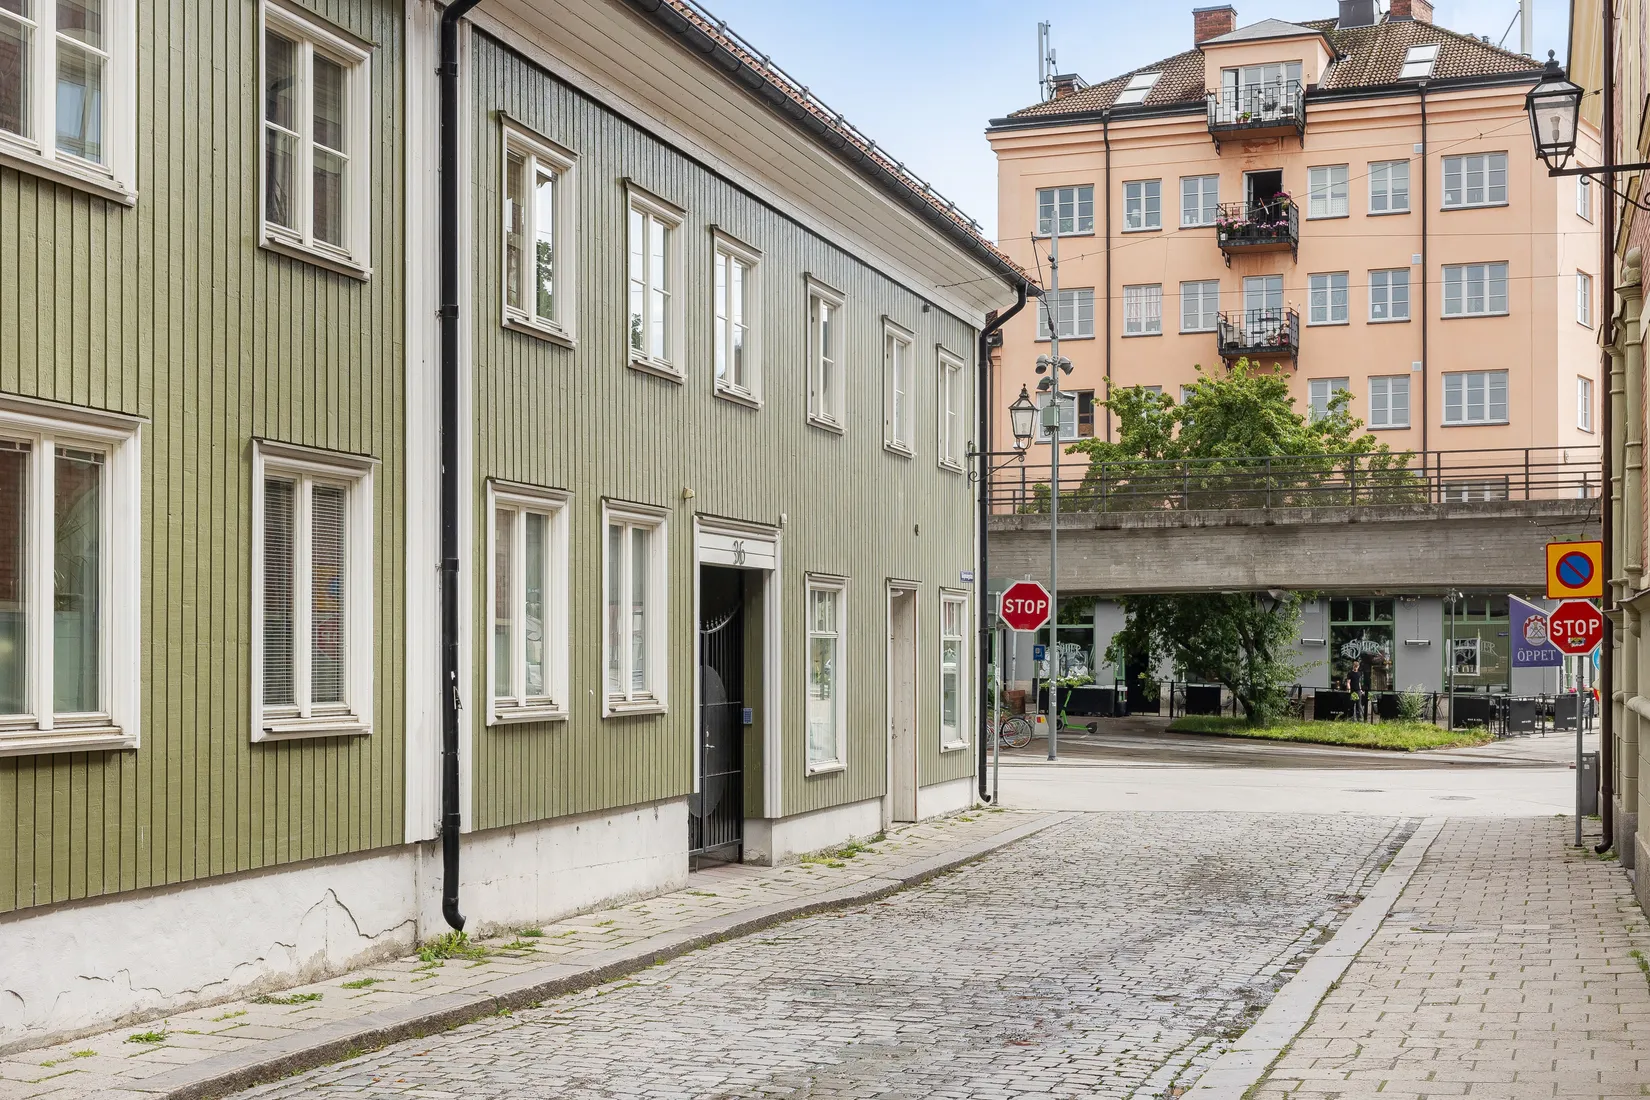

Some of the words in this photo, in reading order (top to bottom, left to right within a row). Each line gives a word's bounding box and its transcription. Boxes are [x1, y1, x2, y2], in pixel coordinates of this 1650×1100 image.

[733, 540, 746, 566] 36
[1005, 598, 1047, 615] STOP
[1552, 618, 1600, 637] STOP
[1517, 647, 1556, 662] ÖPPET
